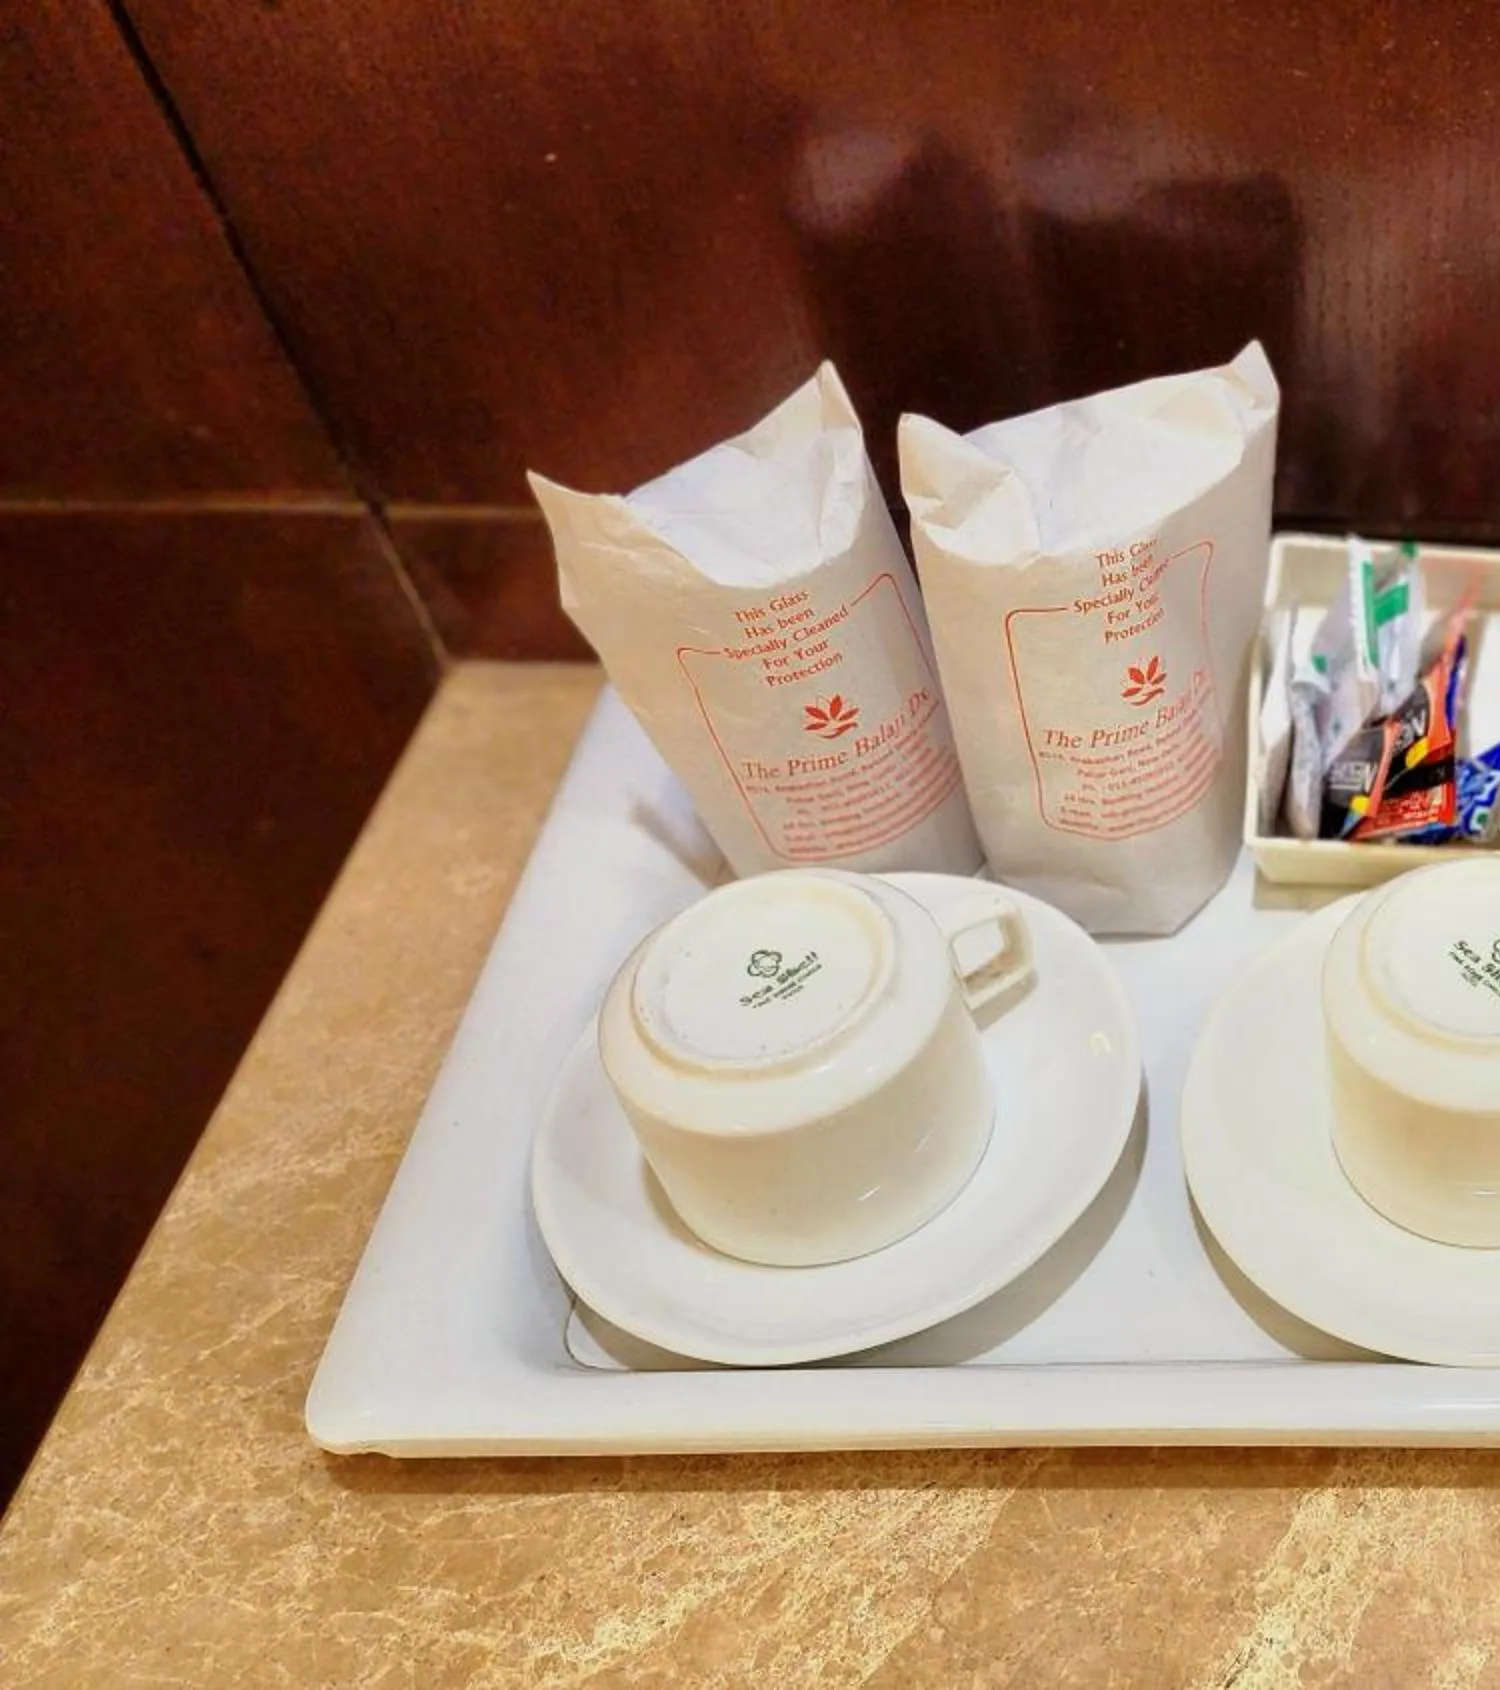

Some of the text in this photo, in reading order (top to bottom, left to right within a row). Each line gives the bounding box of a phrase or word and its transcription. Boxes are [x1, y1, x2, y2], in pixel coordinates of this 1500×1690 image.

[1095, 551, 1125, 569] This
[1101, 571, 1128, 588] Has
[734, 590, 809, 623] This Glass
[1073, 587, 1135, 616] Specially
[1106, 608, 1131, 625] For
[723, 602, 849, 660] Specially Cleaned
[743, 607, 816, 639] Has been
[762, 638, 829, 670] For Your
[765, 651, 843, 687] Protection
[1042, 728, 1083, 750] The
[1091, 719, 1150, 750] Prime
[741, 760, 782, 780] The
[786, 749, 849, 777] Prime
[1453, 940, 1481, 964] Sea
